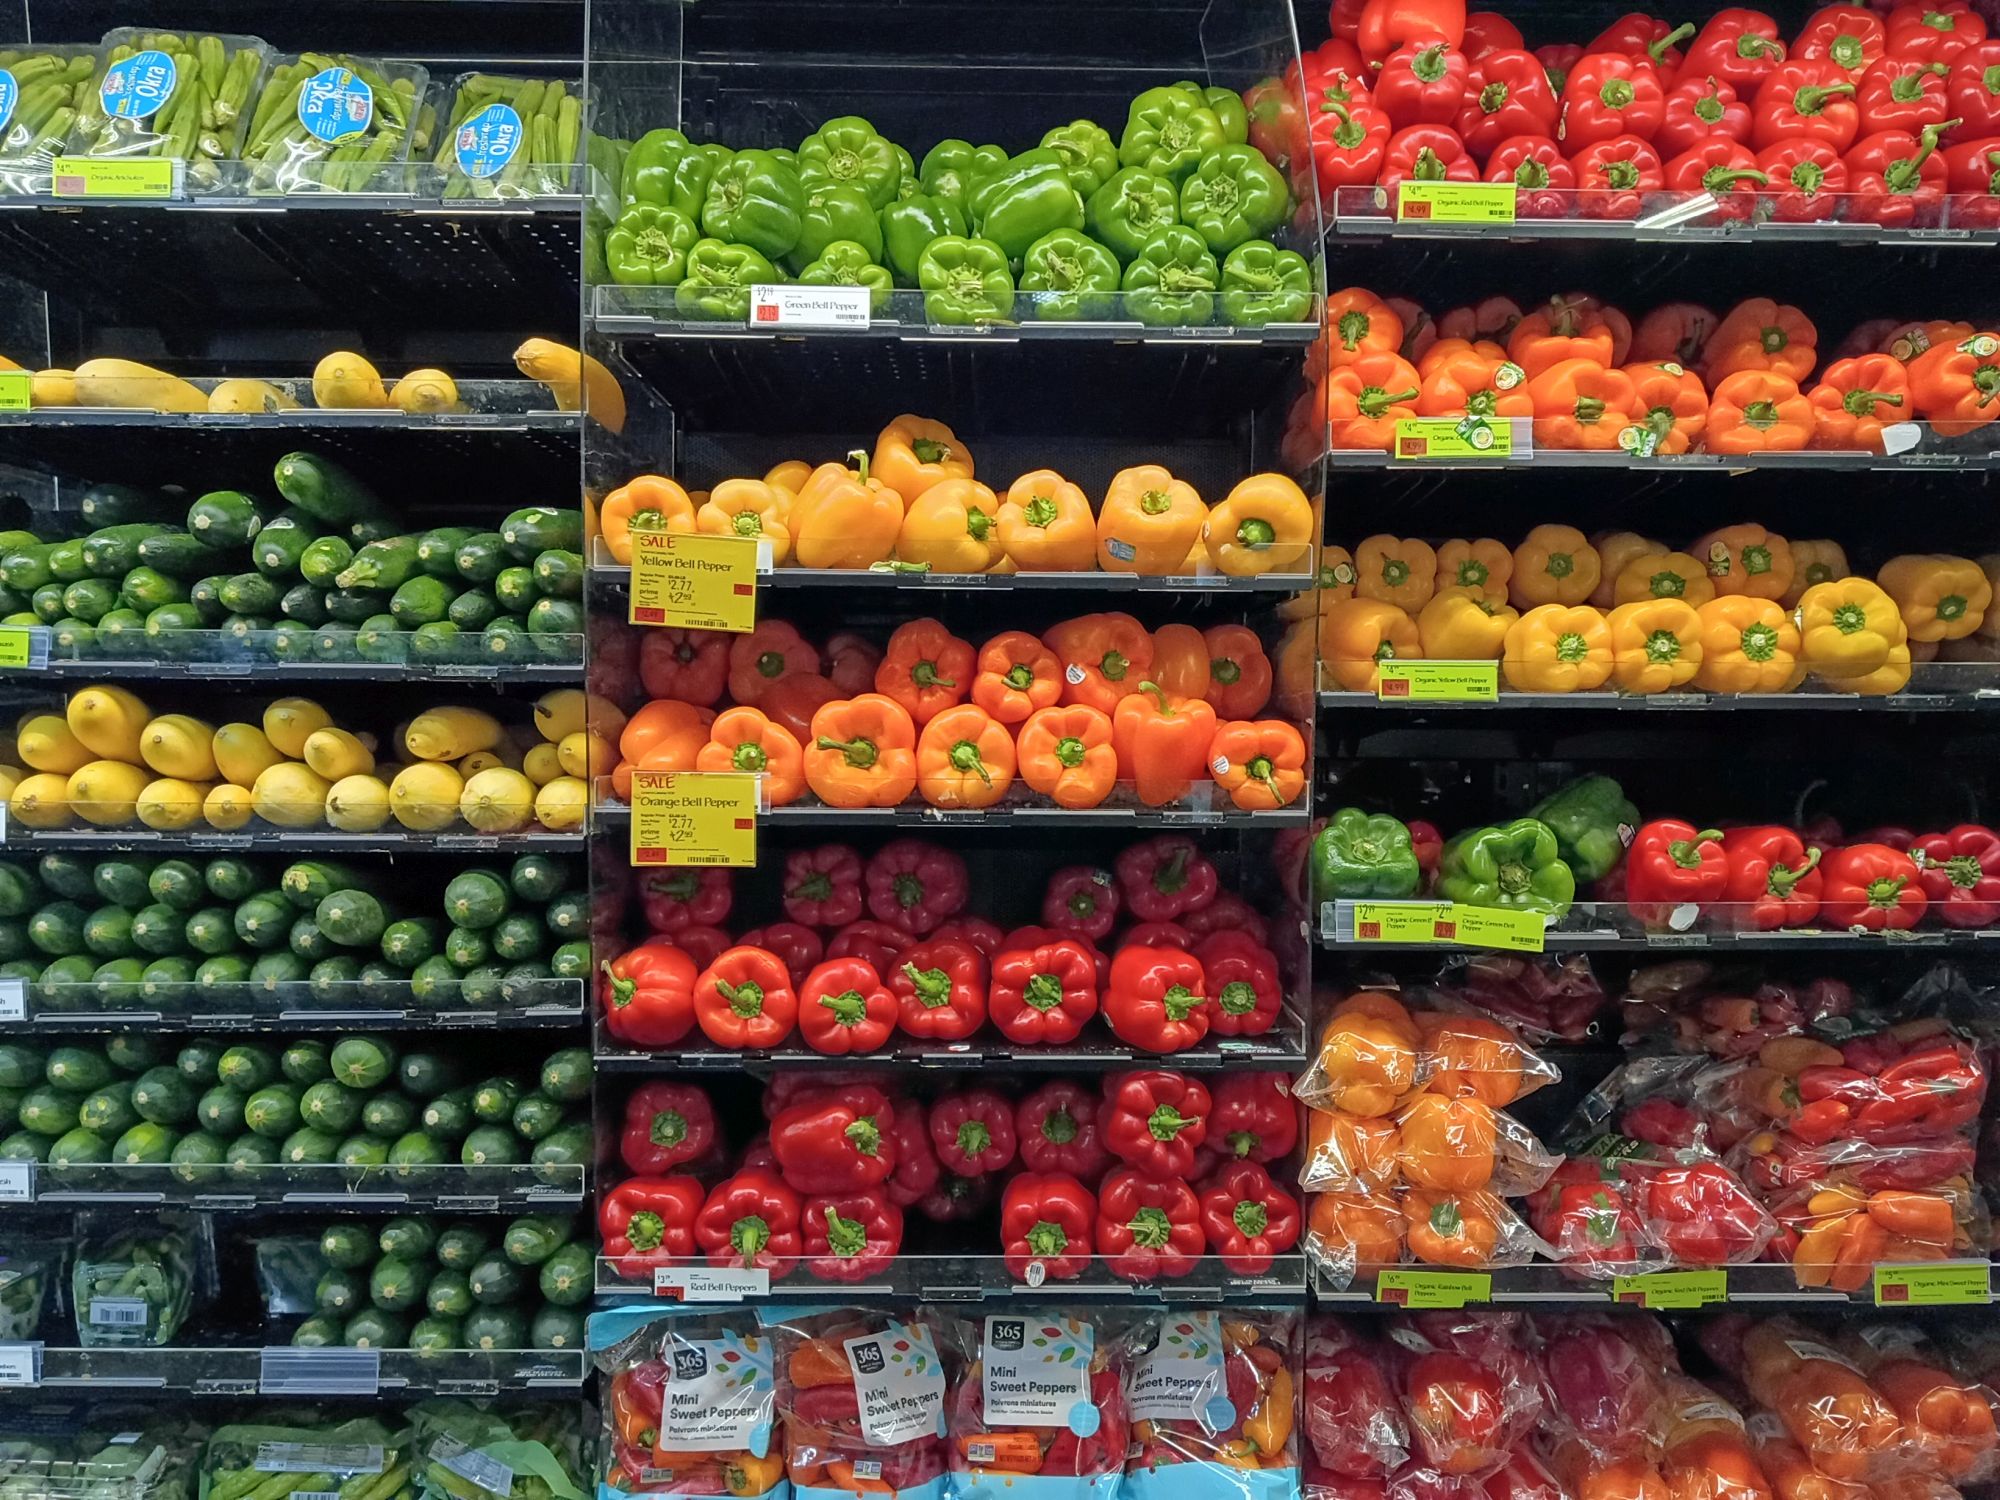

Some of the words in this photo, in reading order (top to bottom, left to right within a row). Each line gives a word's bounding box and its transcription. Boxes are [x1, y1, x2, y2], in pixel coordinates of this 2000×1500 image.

[135, 66, 166, 97] Okra
[489, 124, 514, 156] Okra
[785, 301, 811, 309] Green
[812, 301, 829, 309] Bell
[830, 302, 858, 311] Pepper
[640, 535, 676, 549] SALE
[640, 555, 673, 566] Yellow
[675, 558, 695, 569] Bell
[697, 560, 733, 572] Pepper
[668, 580, 692, 591] $2.77
[639, 775, 675, 789] SALE
[641, 796, 680, 809] Orange
[682, 797, 702, 807] Bell
[704, 797, 739, 808] Pepper
[669, 818, 692, 829] $2.77
[690, 1282, 706, 1291] Red
[708, 1283, 724, 1291] Bell
[725, 1283, 757, 1292] Peppers
[995, 1325, 1021, 1339] 365
[678, 1352, 704, 1370] 365
[857, 1346, 880, 1364] 365
[990, 1366, 1016, 1377] Mini
[1136, 1364, 1153, 1381] Mini
[990, 1381, 1026, 1392] Sweet
[1029, 1381, 1077, 1395] Peppers
[1134, 1380, 1165, 1392] Sweet
[1165, 1376, 1211, 1389] Peppes
[671, 1394, 699, 1405] Mini
[864, 1386, 888, 1403] Mini
[991, 1399, 1018, 1407] Poivrons
[1020, 1399, 1056, 1407] miniatures
[670, 1407, 709, 1420] Sweet
[669, 1425, 699, 1433] Poivrons
